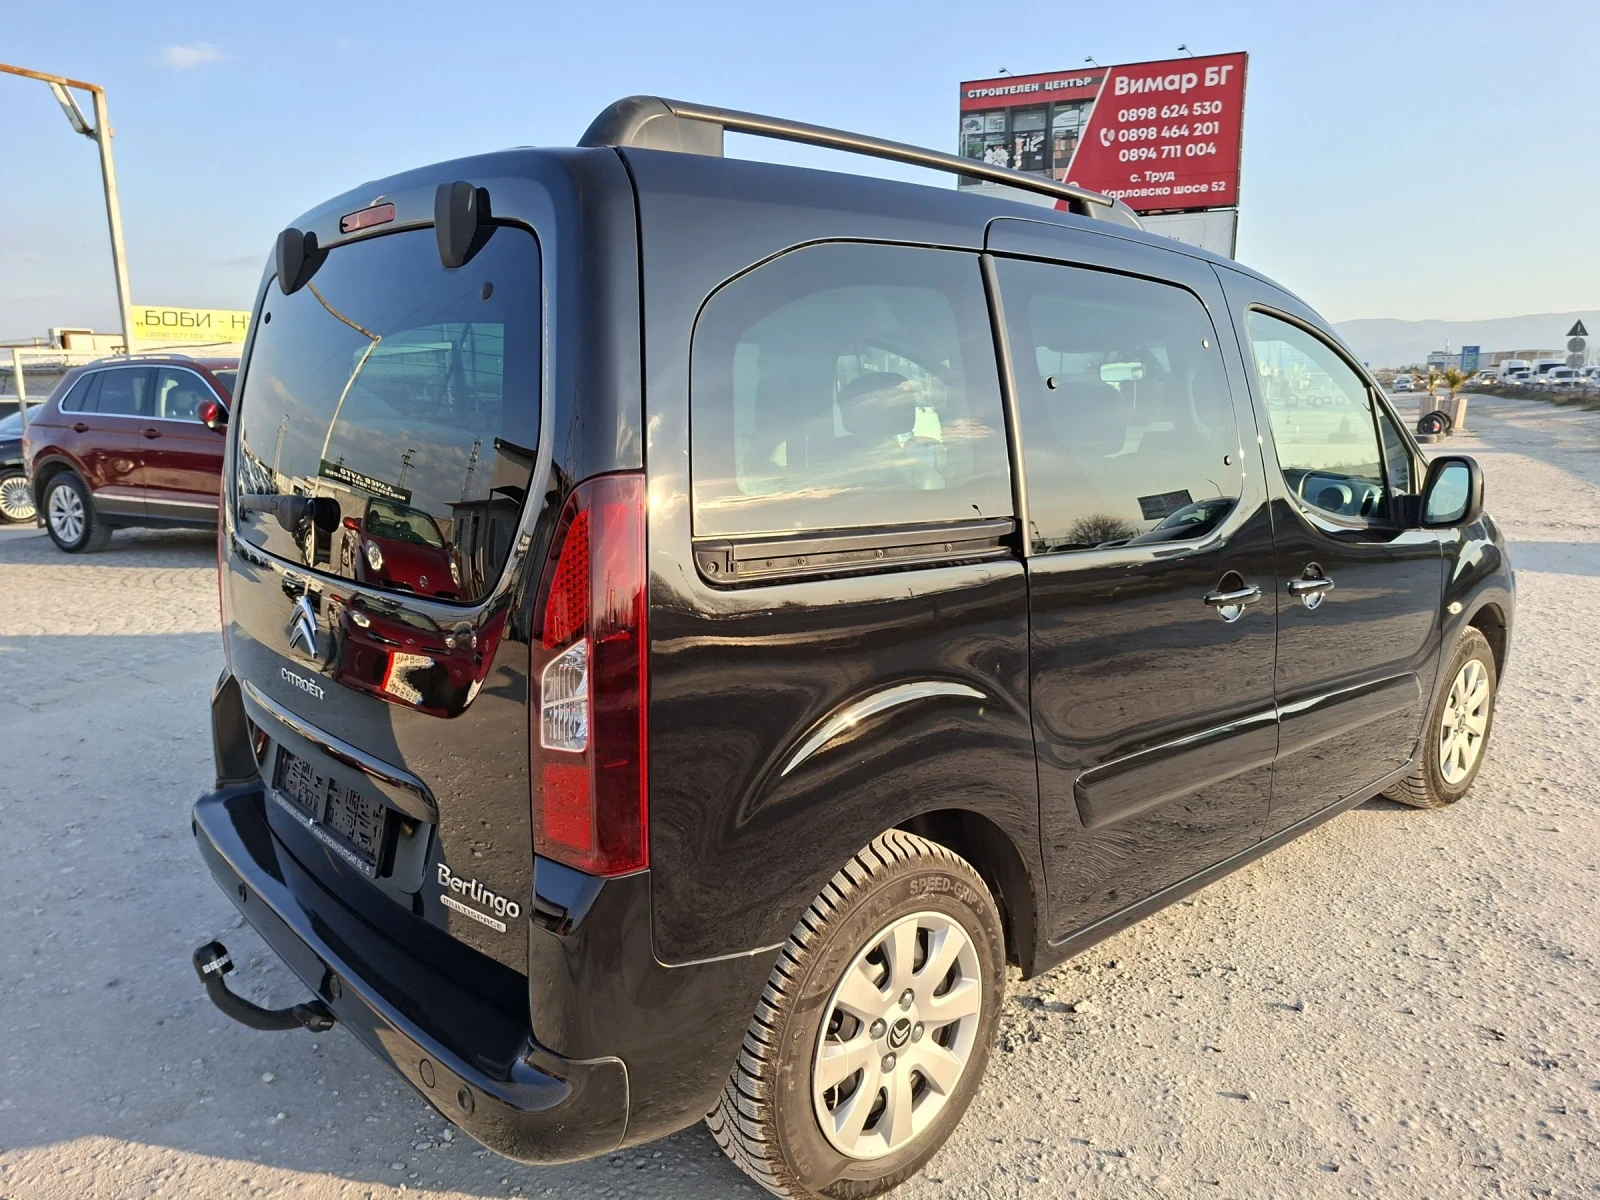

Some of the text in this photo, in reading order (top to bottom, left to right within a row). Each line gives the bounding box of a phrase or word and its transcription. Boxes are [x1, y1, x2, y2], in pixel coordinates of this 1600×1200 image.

[967, 77, 1092, 98] СТРОИТЕЛЕН ЦЕНТЪР
[1115, 65, 1234, 95] Вимар БГ
[1118, 101, 1222, 122] 0898 624 530
[1118, 121, 1219, 142] 0898 464 201
[1119, 142, 1216, 162] 0894 711 004
[1129, 171, 1175, 183] с. Труд
[1101, 181, 1226, 200] Карловско шосе 52
[281, 668, 325, 700] CITROËN
[437, 863, 520, 918] Berlingo
[910, 876, 978, 905] SPEED-GRIP
[442, 897, 504, 930] MULTISPACE
